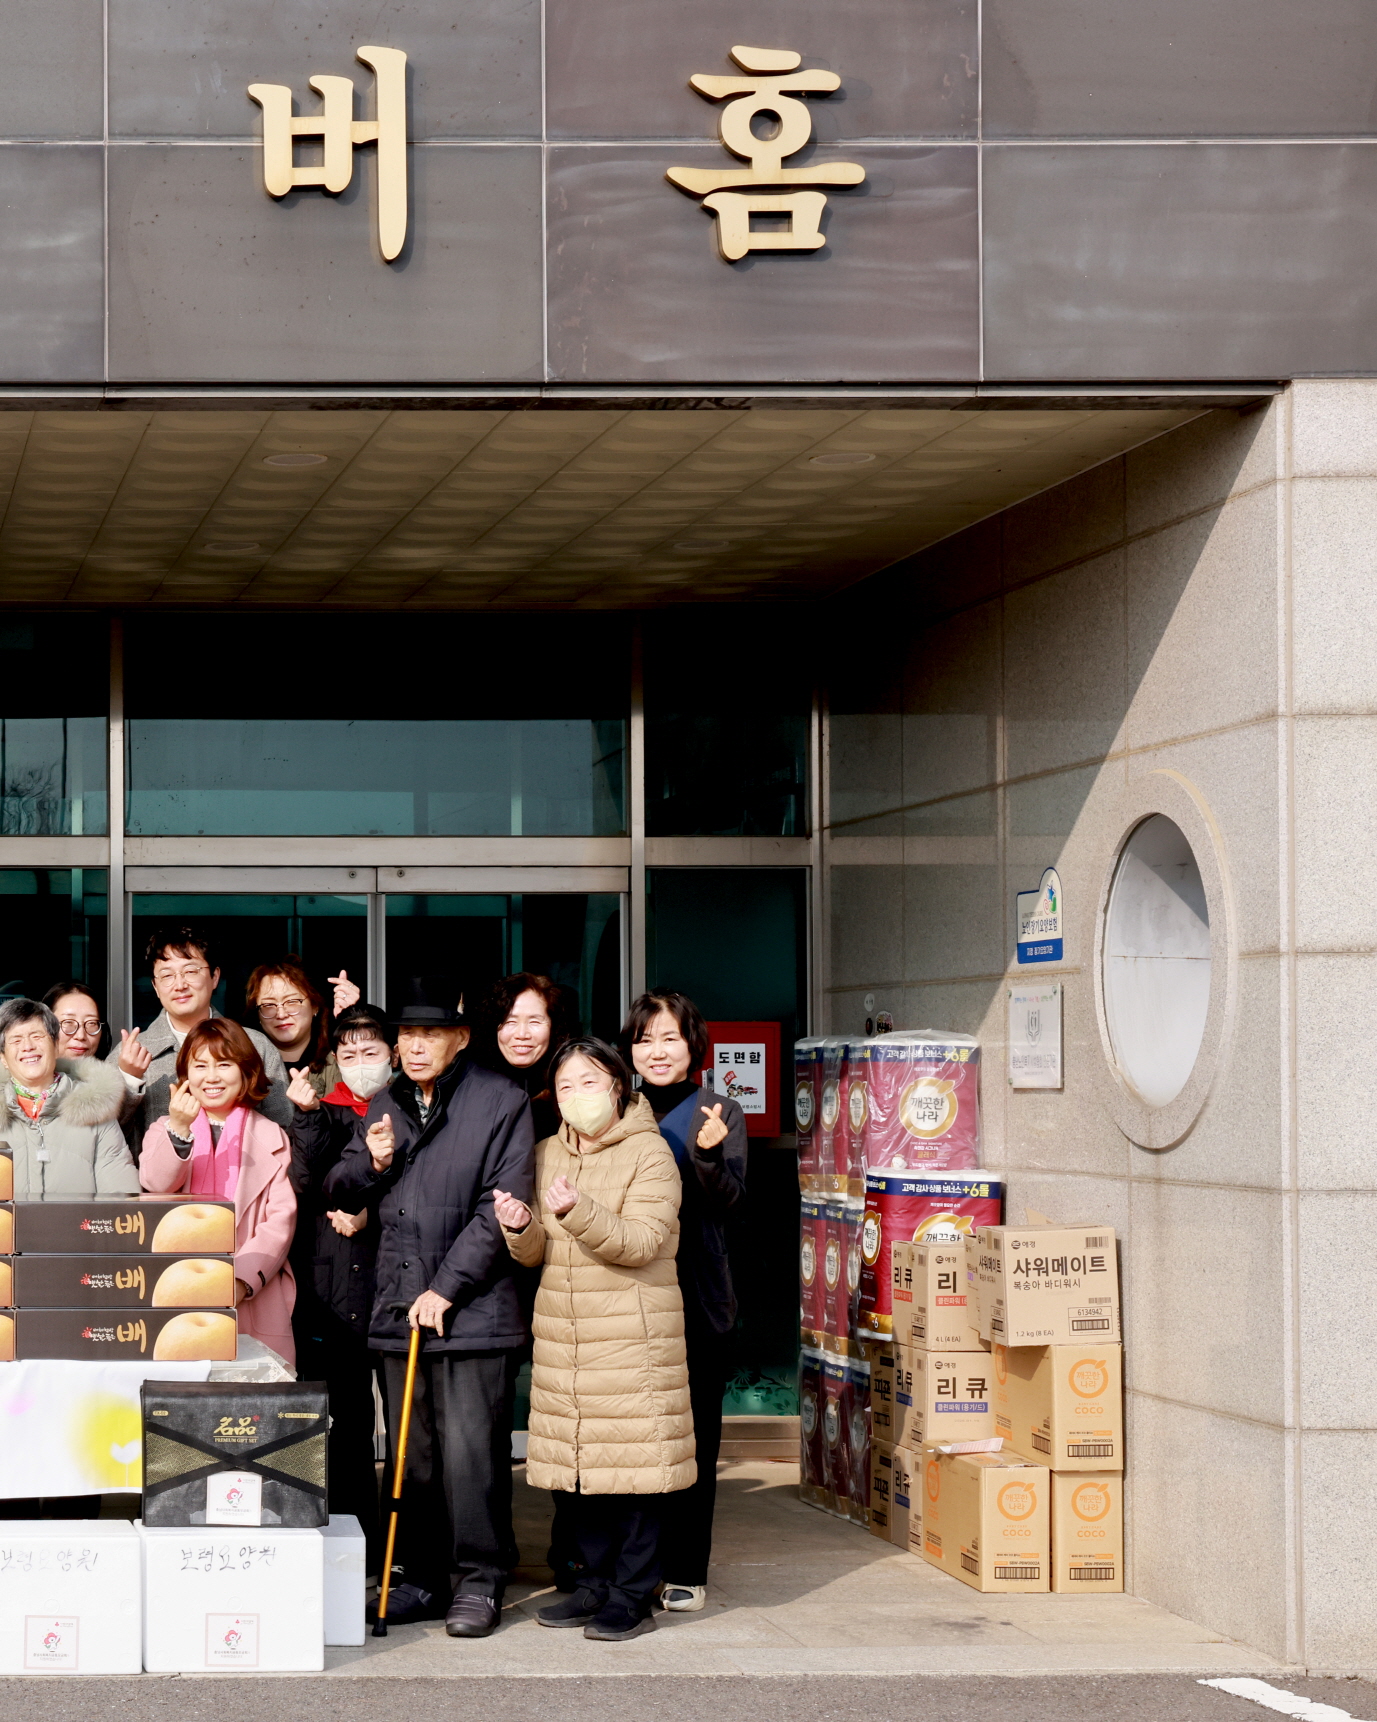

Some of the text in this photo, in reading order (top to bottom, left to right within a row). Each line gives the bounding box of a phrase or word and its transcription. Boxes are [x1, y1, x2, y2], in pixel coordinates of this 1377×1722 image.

[719, 1051, 761, 1064] 도면함
[911, 1097, 944, 1110] 깨끗한
[916, 1111, 939, 1123] 나라
[901, 1183, 990, 1197] 고객 감사 상품 보너스 +6롤
[116, 1211, 145, 1245] 배
[1013, 1255, 1107, 1278] 샤워메이트
[116, 1266, 145, 1299] 배
[894, 1266, 912, 1289] 리큐
[1013, 1278, 1081, 1291] 복숭아 바디워시
[1077, 1308, 1103, 1316] 6134942
[117, 1319, 146, 1353] 배
[897, 1369, 913, 1394] 리큐
[1076, 1371, 1100, 1380] 깨끗한
[937, 1377, 988, 1400] 리큐
[1080, 1380, 1097, 1389] 나라
[937, 1403, 960, 1411] 클린파워
[1074, 1406, 1104, 1414] COCO
[1005, 1493, 1028, 1503] 깨끗한
[1079, 1494, 1103, 1504] 깨끗한
[1009, 1503, 1026, 1511] 나라
[1083, 1503, 1100, 1512] 나라
[1002, 1529, 1032, 1537] COCO
[1077, 1530, 1106, 1538] COCO
